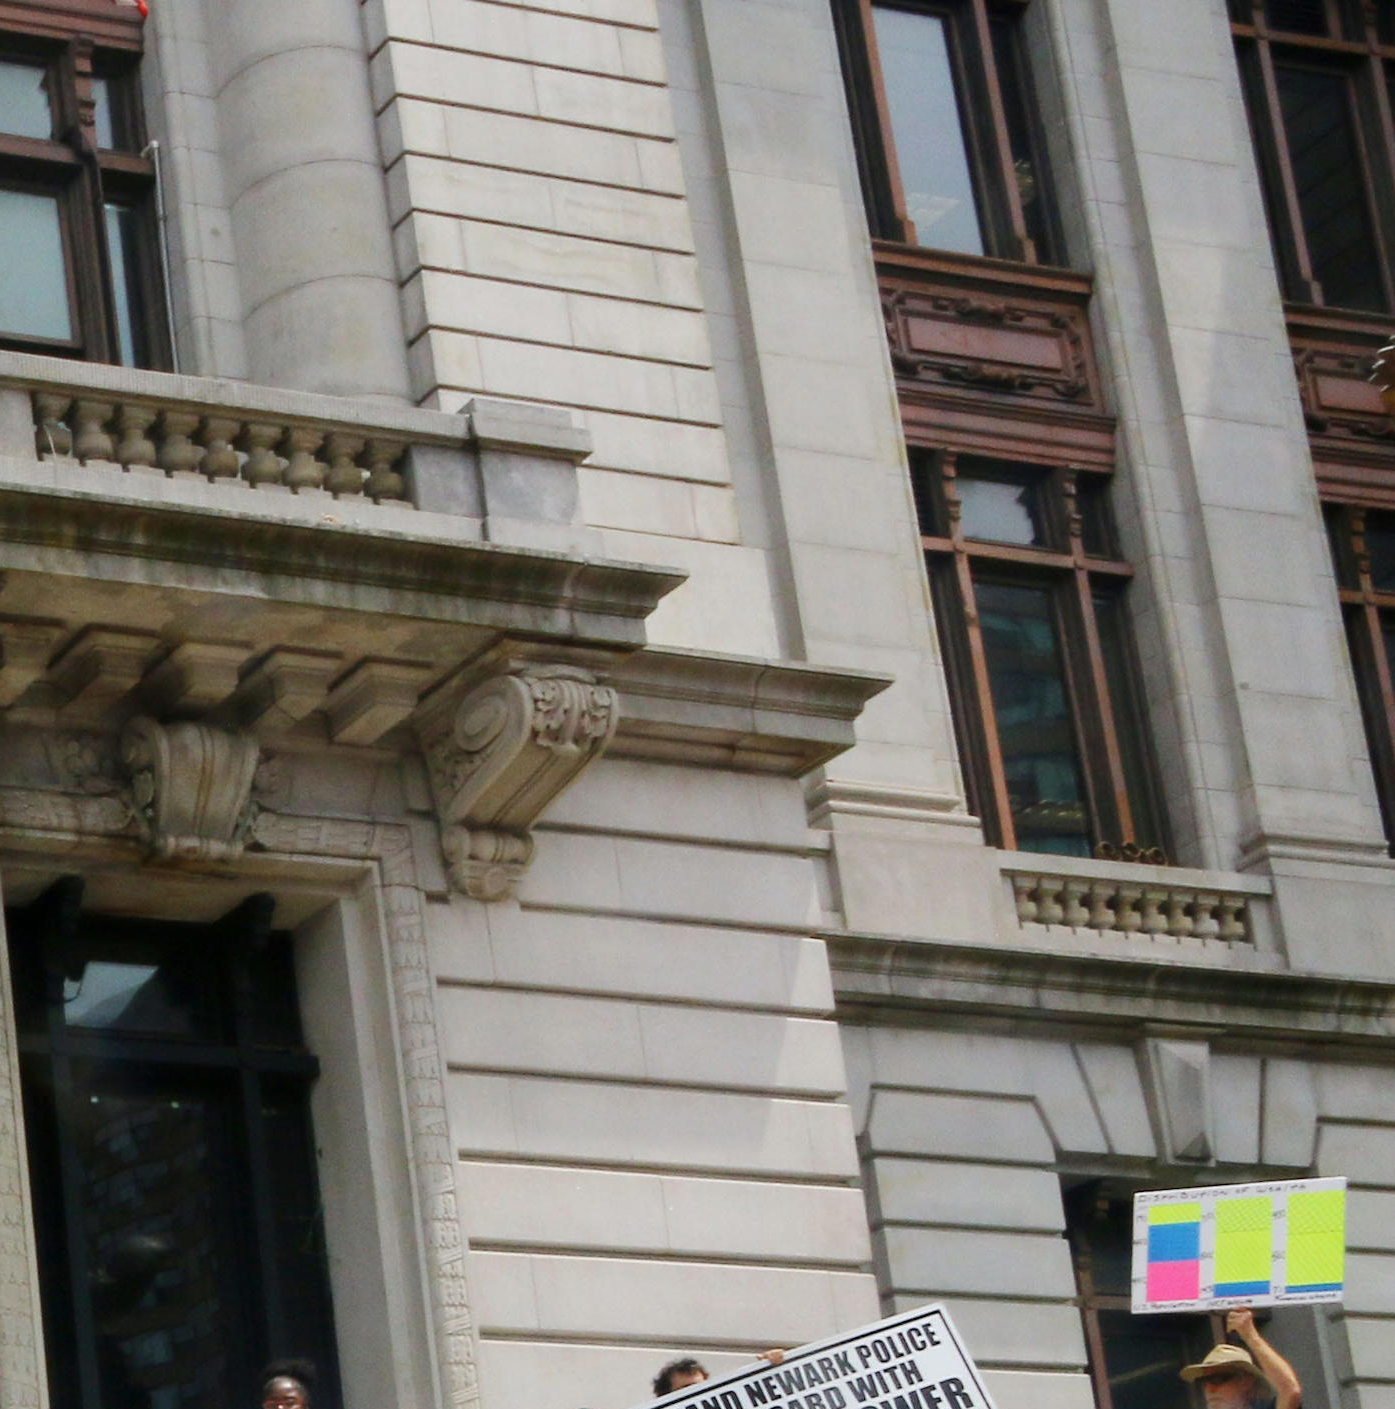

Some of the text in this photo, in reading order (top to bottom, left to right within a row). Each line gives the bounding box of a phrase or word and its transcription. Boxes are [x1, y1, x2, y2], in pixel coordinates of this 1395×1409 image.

[742, 1350, 860, 1406] NEWARK
[855, 1322, 942, 1370] POLICE
[850, 1360, 924, 1404] WITH
